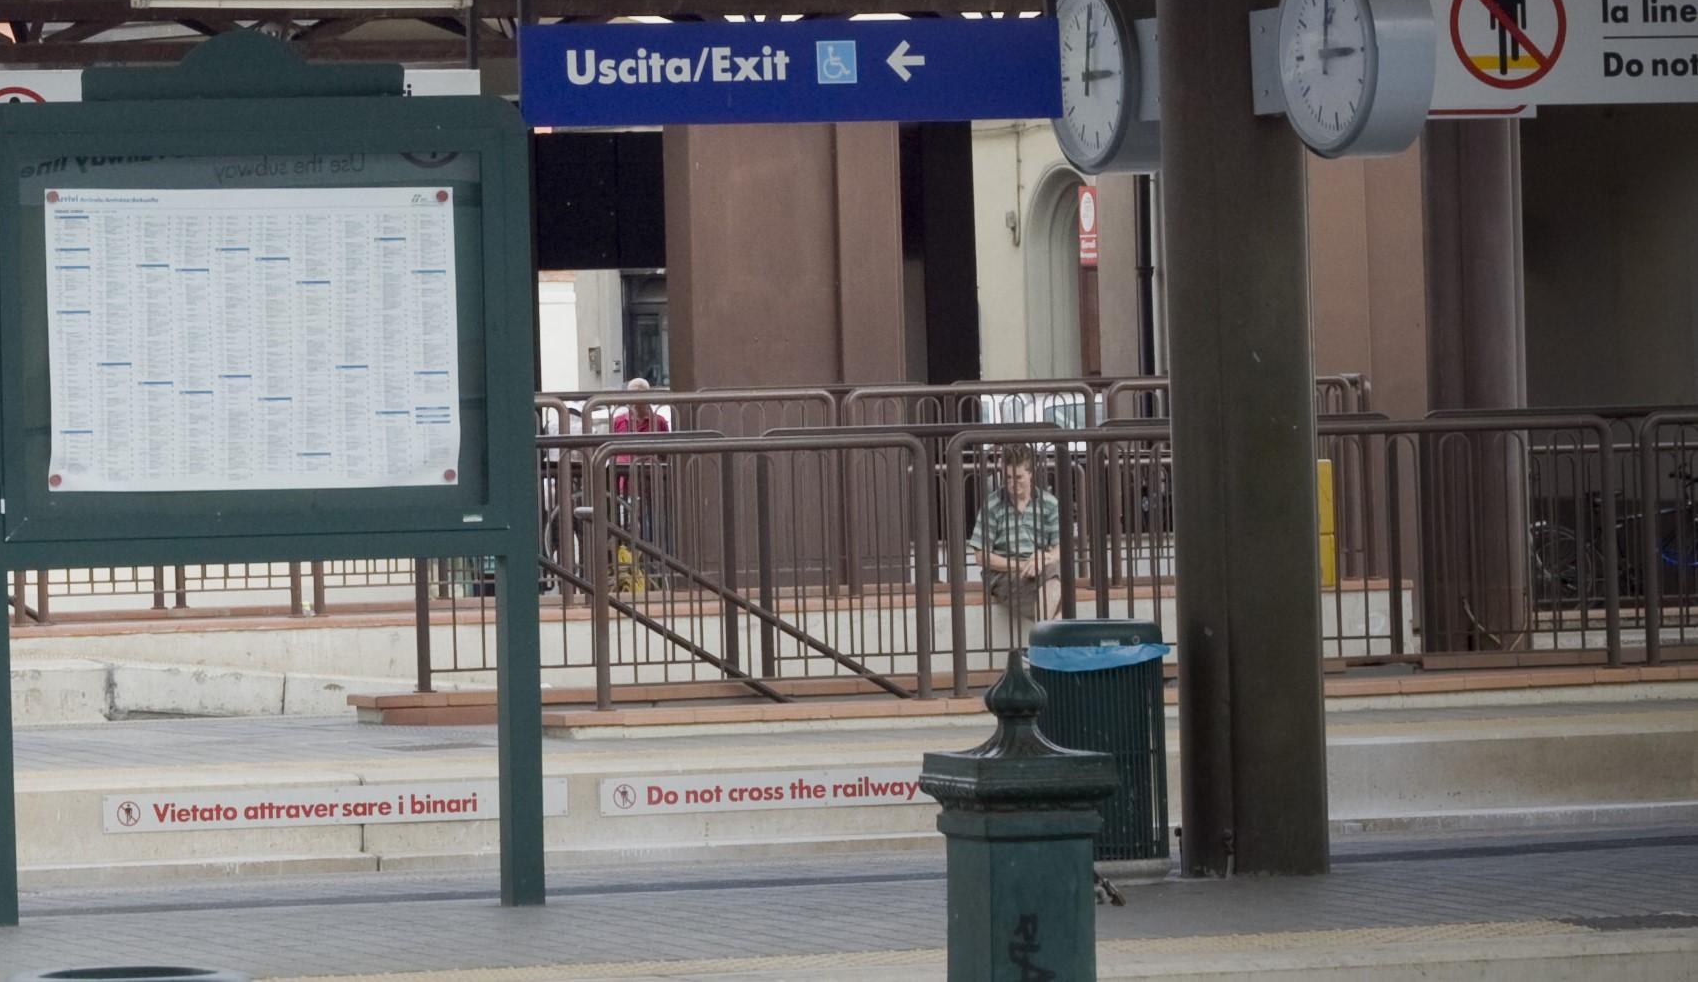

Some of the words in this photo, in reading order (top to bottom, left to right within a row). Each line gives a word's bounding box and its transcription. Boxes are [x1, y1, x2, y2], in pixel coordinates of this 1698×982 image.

[565, 45, 791, 86] Uscita/Exit
[1603, 51, 1644, 78] Do
[646, 785, 679, 806] Do
[685, 783, 723, 804] not
[728, 784, 784, 803] cross
[789, 777, 826, 800] the
[832, 776, 918, 801] railway
[153, 802, 238, 824] Vietato
[398, 794, 404, 815] i
[411, 792, 478, 815] binari
